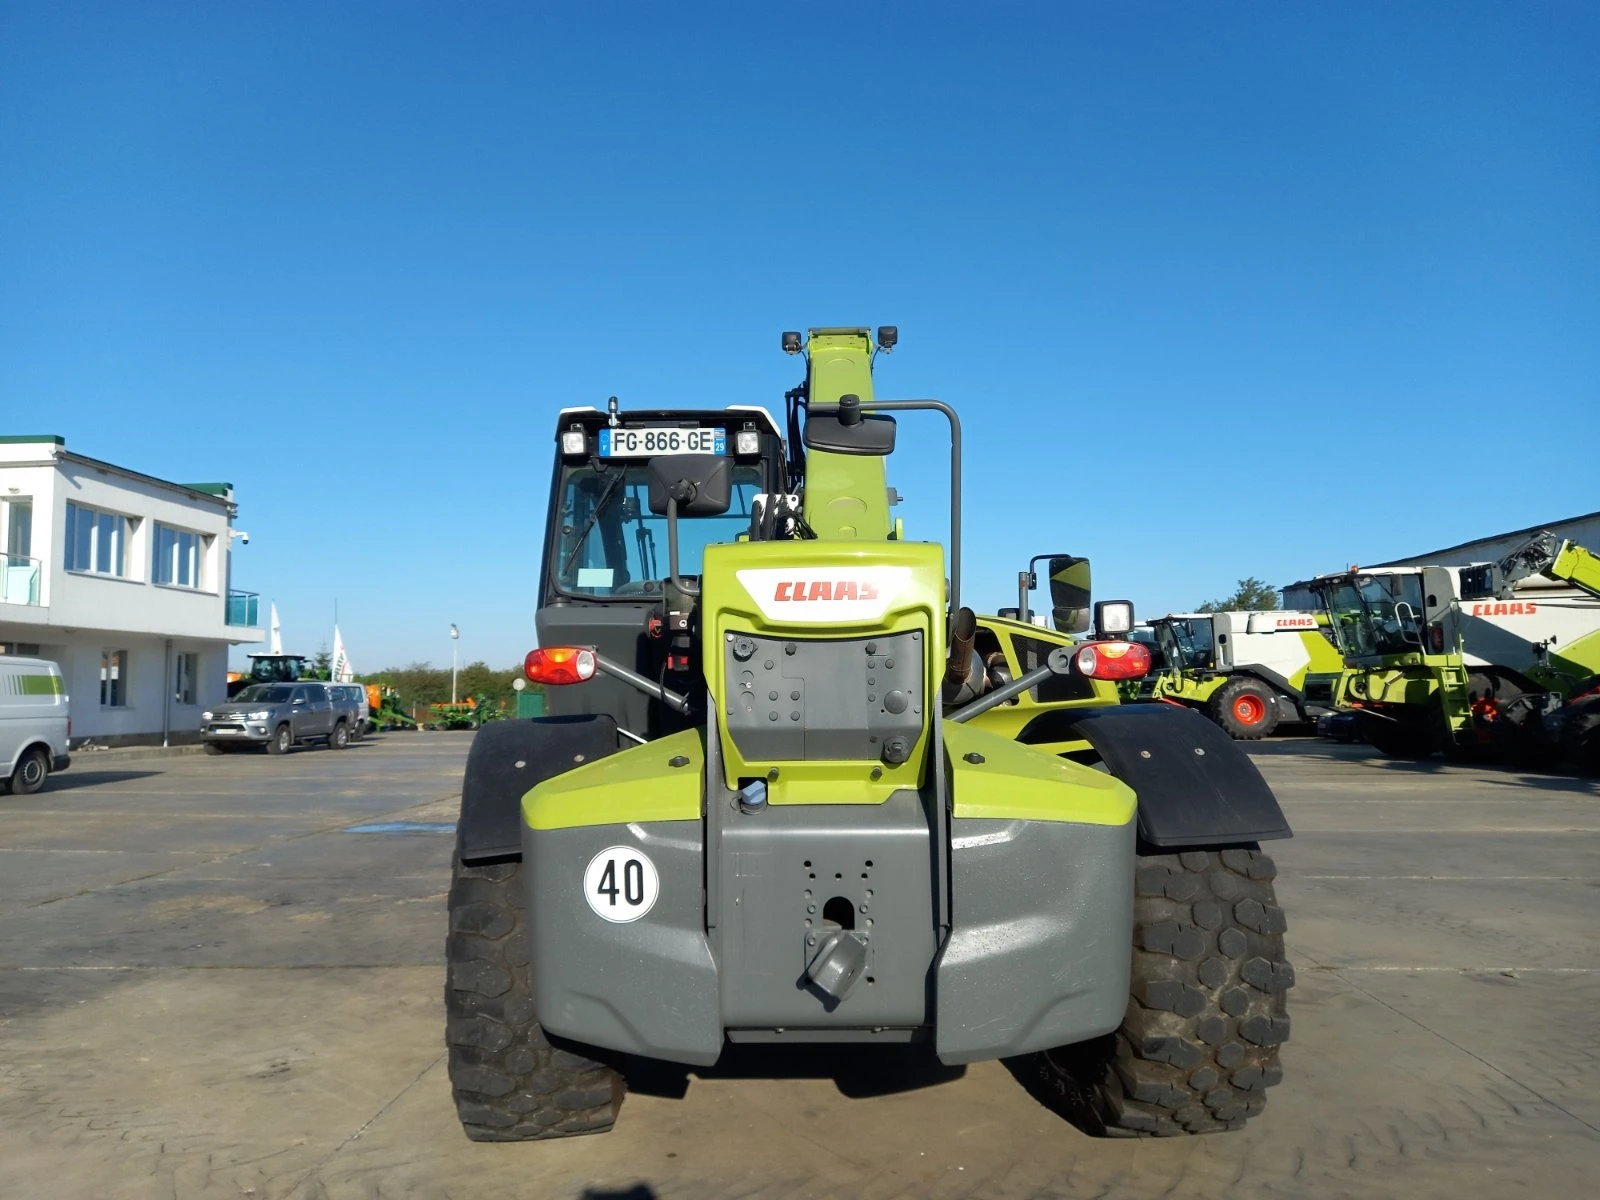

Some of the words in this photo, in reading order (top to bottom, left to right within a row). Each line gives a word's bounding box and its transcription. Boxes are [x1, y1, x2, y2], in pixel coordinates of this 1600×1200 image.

[613, 431, 712, 451] FG-866-GE
[715, 442, 725, 451] 29
[774, 581, 879, 602] CLAAS
[1472, 603, 1537, 617] CLAAS
[1276, 618, 1313, 627] CLAAS
[597, 859, 644, 906] 40
